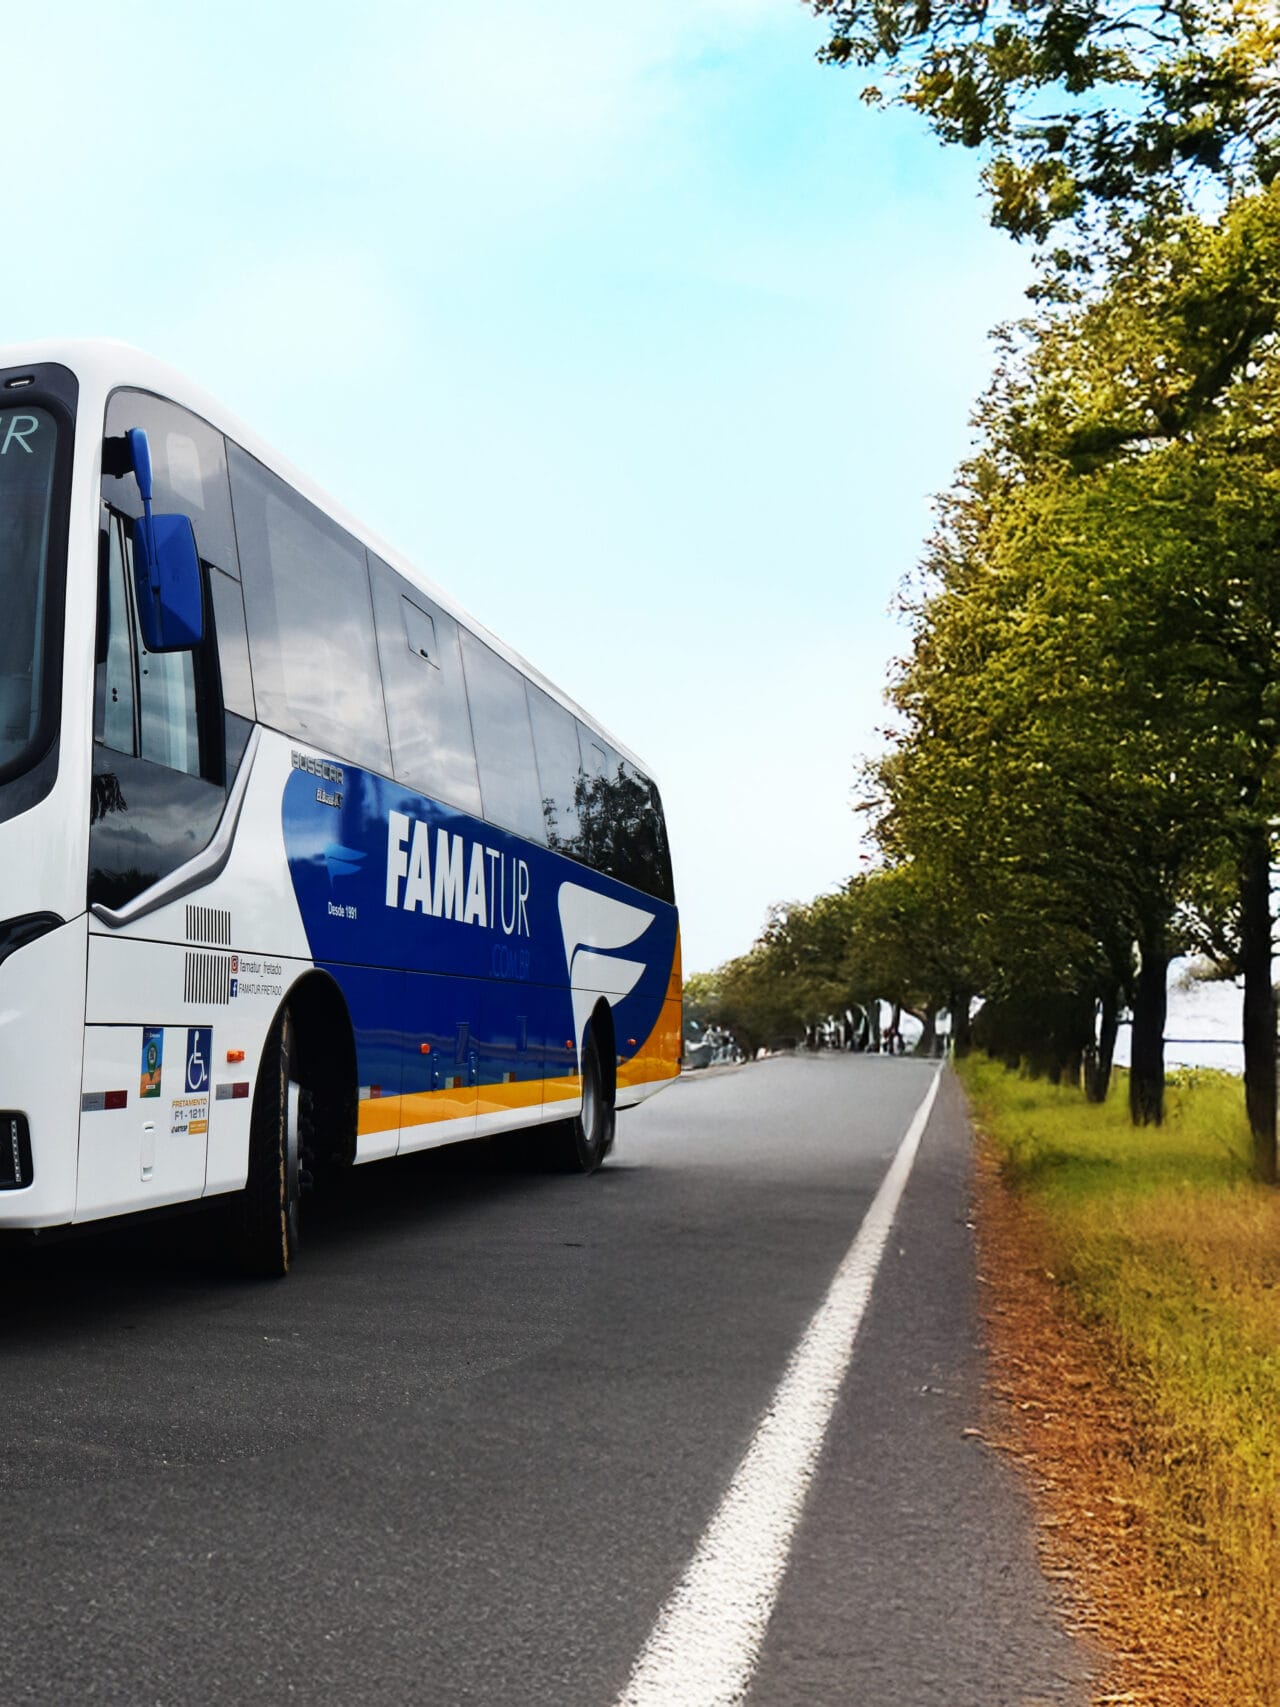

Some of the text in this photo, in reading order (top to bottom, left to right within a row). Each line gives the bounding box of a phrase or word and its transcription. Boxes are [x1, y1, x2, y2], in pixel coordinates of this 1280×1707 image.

[291, 750, 344, 785] BUSSCAR
[385, 809, 531, 938] FAMATUR
[328, 901, 357, 920] Desde 1991
[172, 1098, 208, 1109] FRETAMENTO
[189, 1108, 206, 1120] 1211
